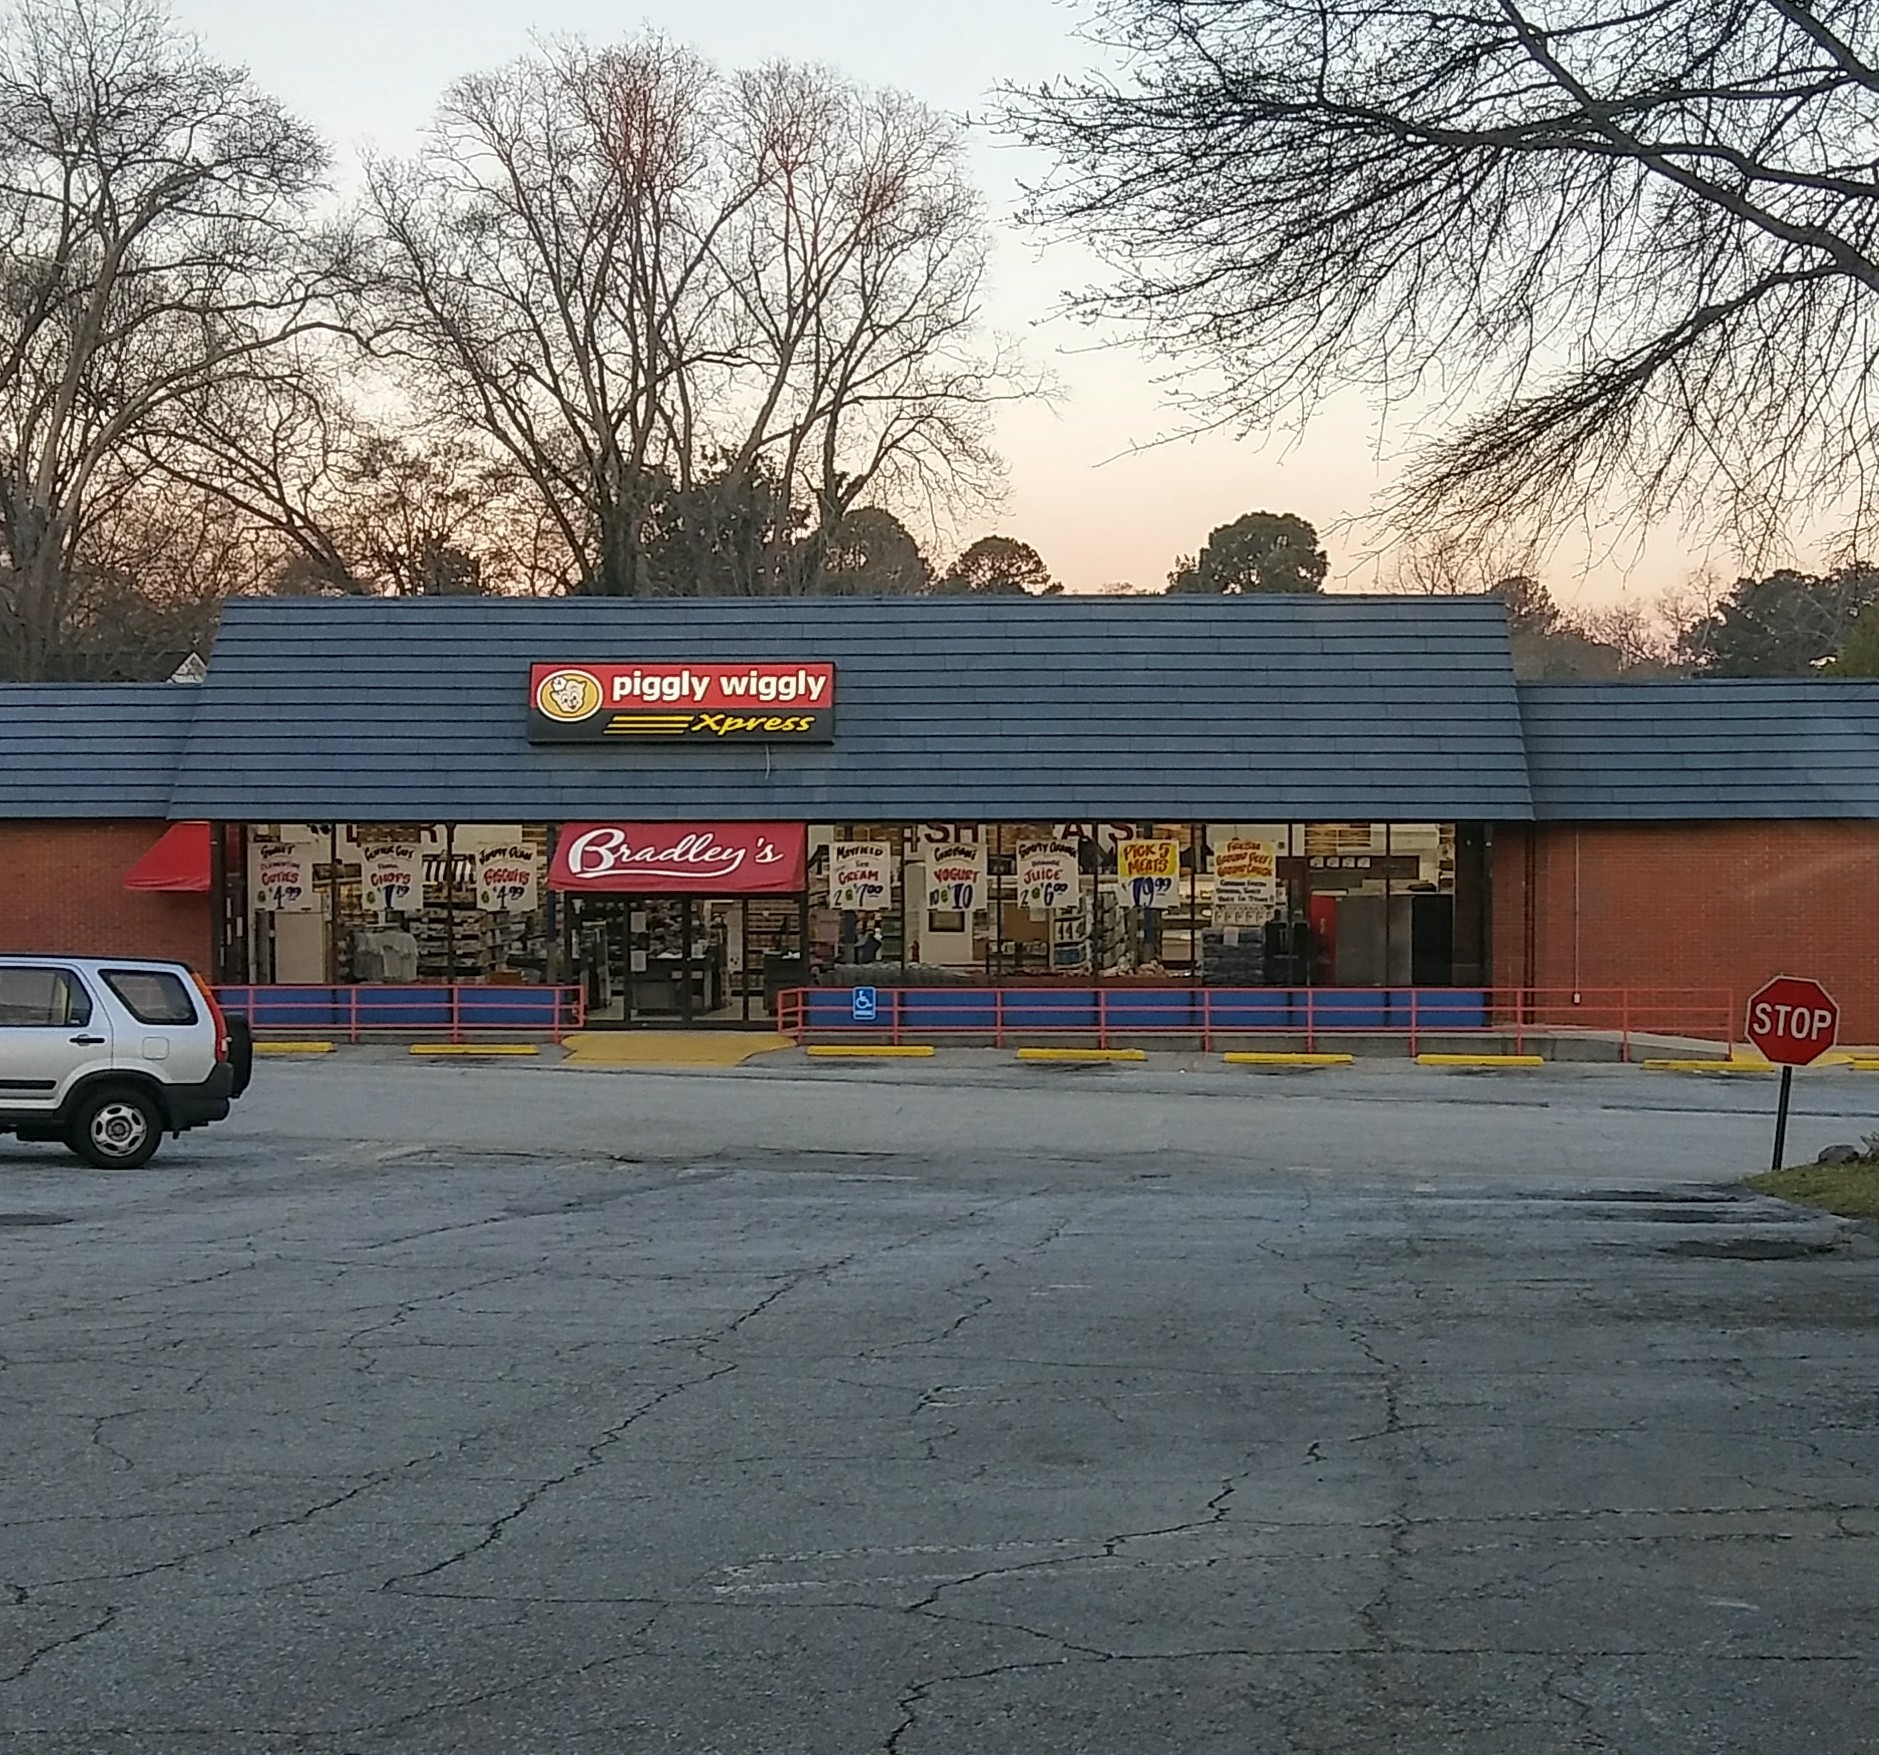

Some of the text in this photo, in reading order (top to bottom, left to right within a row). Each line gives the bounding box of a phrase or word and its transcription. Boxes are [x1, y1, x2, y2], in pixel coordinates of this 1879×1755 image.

[612, 670, 826, 701] piggly wiggly
[691, 713, 815, 735] Xpress
[568, 828, 784, 878] Bradley's
[1123, 843, 1171, 861] PICK 5
[933, 867, 981, 884] YOGURT
[1023, 867, 1064, 885] JUICE
[1127, 859, 1169, 876] MEATS
[370, 872, 412, 887] CHOPS
[838, 870, 879, 886] CREAM
[1753, 1003, 1832, 1040] STOP
